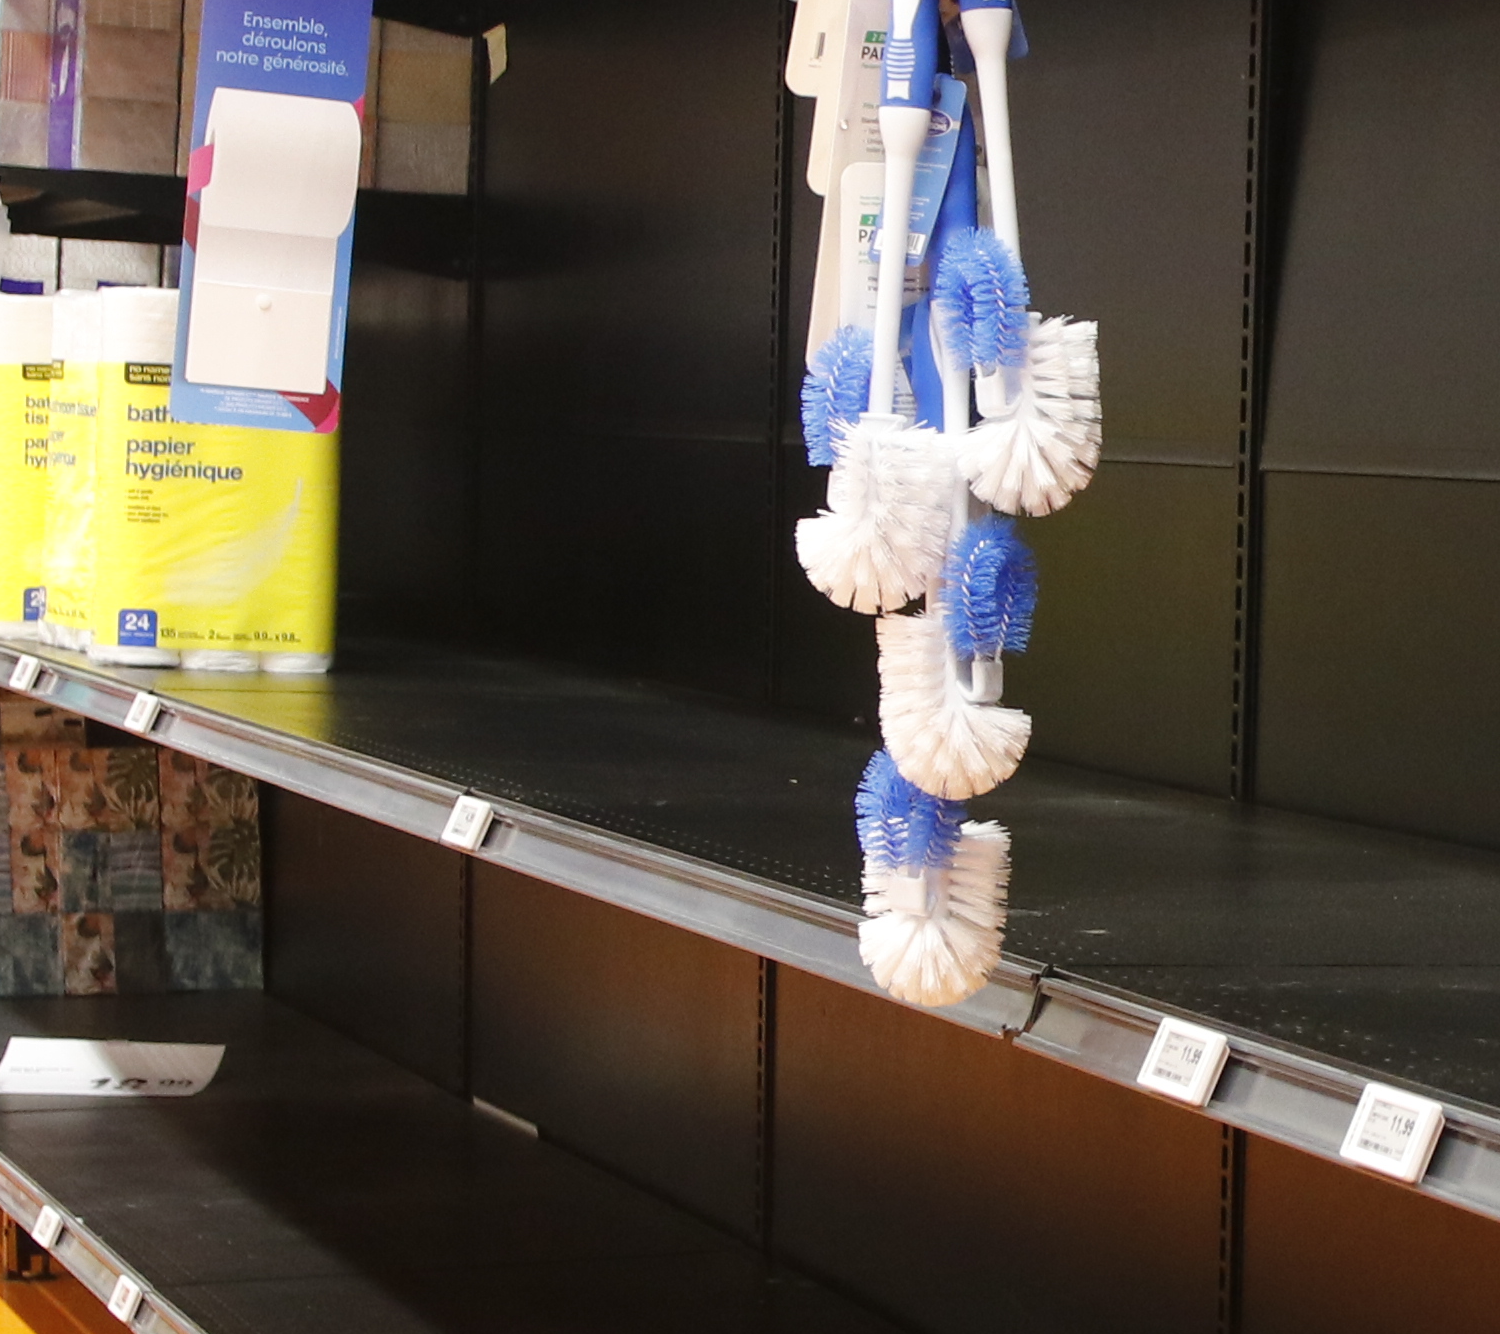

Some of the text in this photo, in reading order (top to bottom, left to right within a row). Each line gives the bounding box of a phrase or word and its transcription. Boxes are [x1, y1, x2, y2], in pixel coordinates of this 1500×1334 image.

[244, 11, 328, 37] Ensemble,
[242, 30, 327, 55] déroulons
[216, 50, 349, 78] notre générosité.
[126, 437, 196, 458] papier
[125, 457, 243, 485] hygiénique
[125, 613, 151, 632] 24
